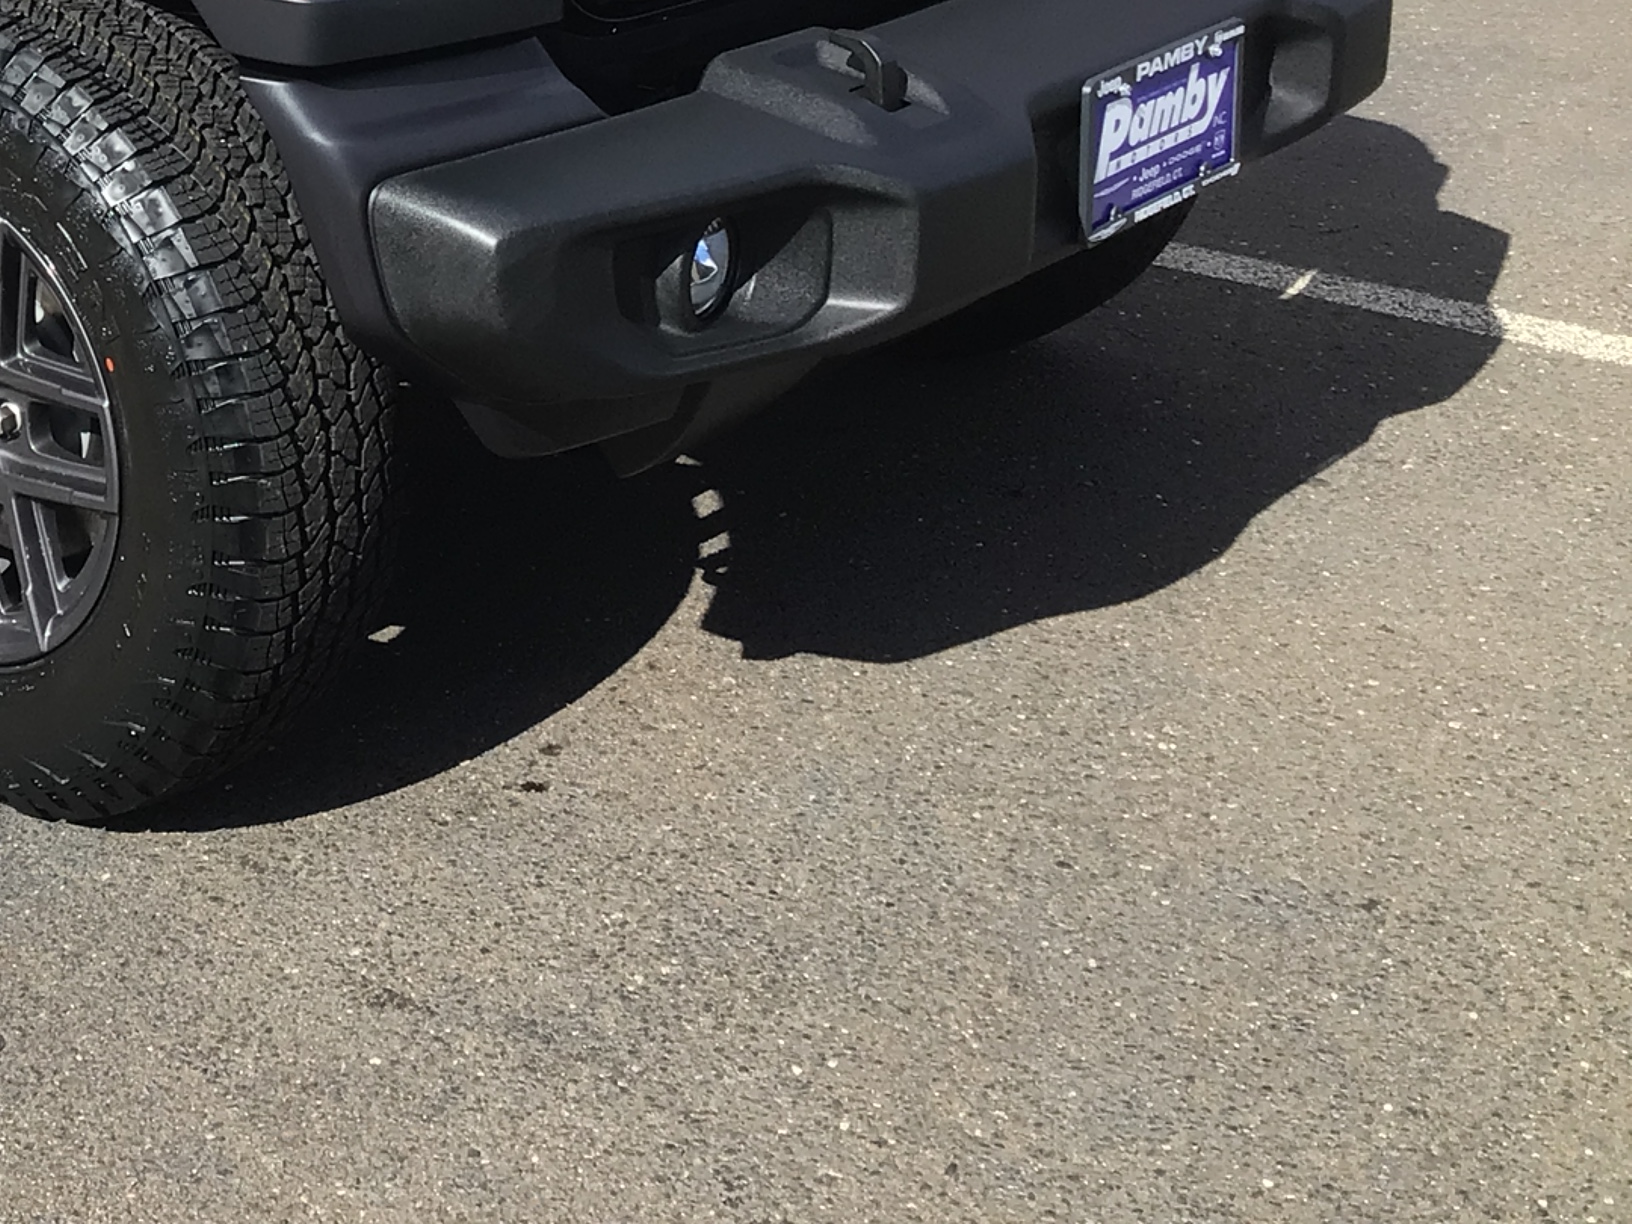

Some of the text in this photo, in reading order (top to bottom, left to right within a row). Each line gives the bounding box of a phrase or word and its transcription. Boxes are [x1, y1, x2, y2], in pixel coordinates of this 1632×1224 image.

[1136, 36, 1208, 82] PAMBY
[1094, 62, 1230, 185] Pamby
[1139, 164, 1161, 182] Jeep
